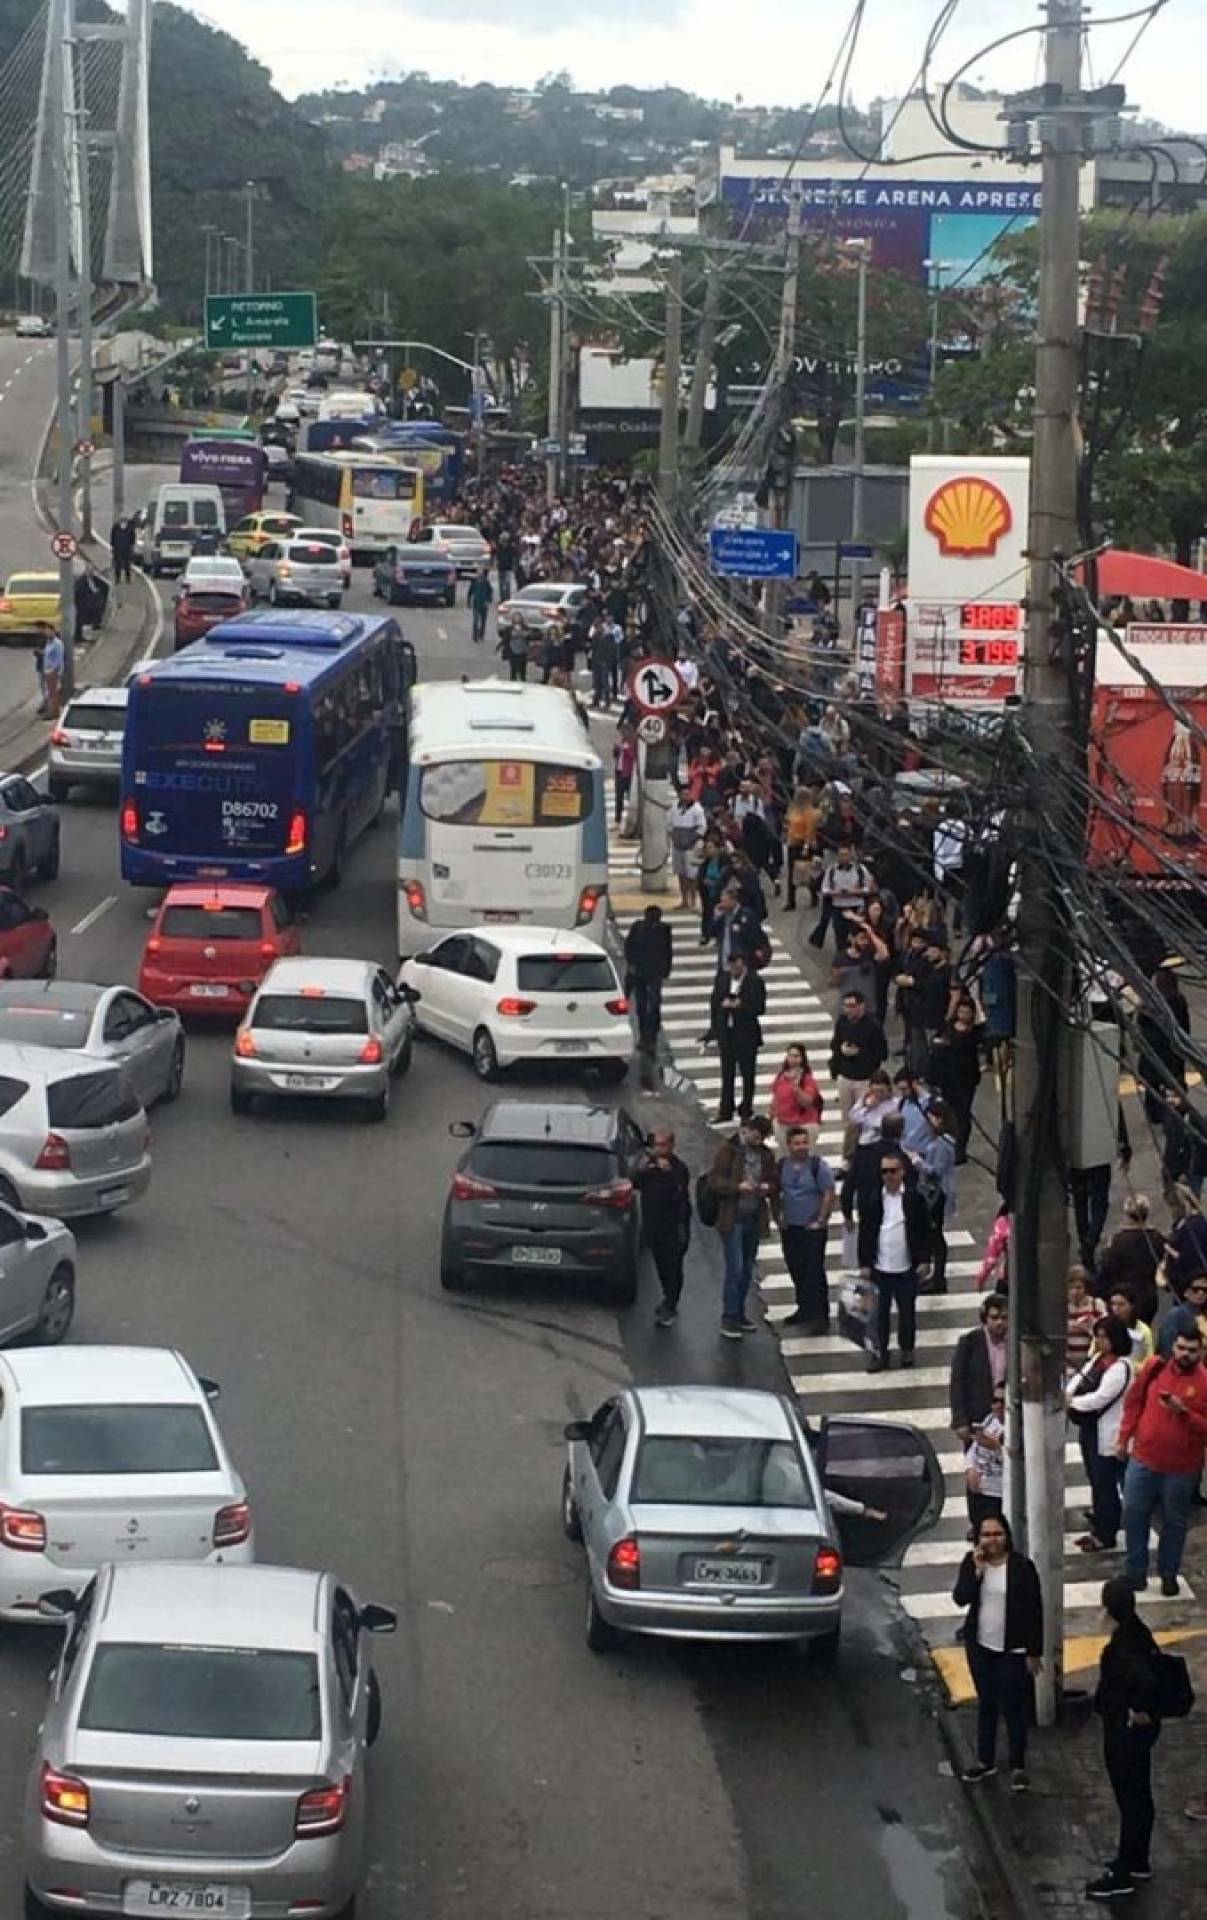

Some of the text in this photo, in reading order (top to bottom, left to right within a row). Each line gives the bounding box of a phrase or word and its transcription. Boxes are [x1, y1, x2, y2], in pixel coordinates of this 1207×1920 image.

[875, 189, 951, 207] ARENA
[643, 718, 661, 734] 40
[221, 801, 279, 819] D86702
[523, 862, 573, 880] C30123
